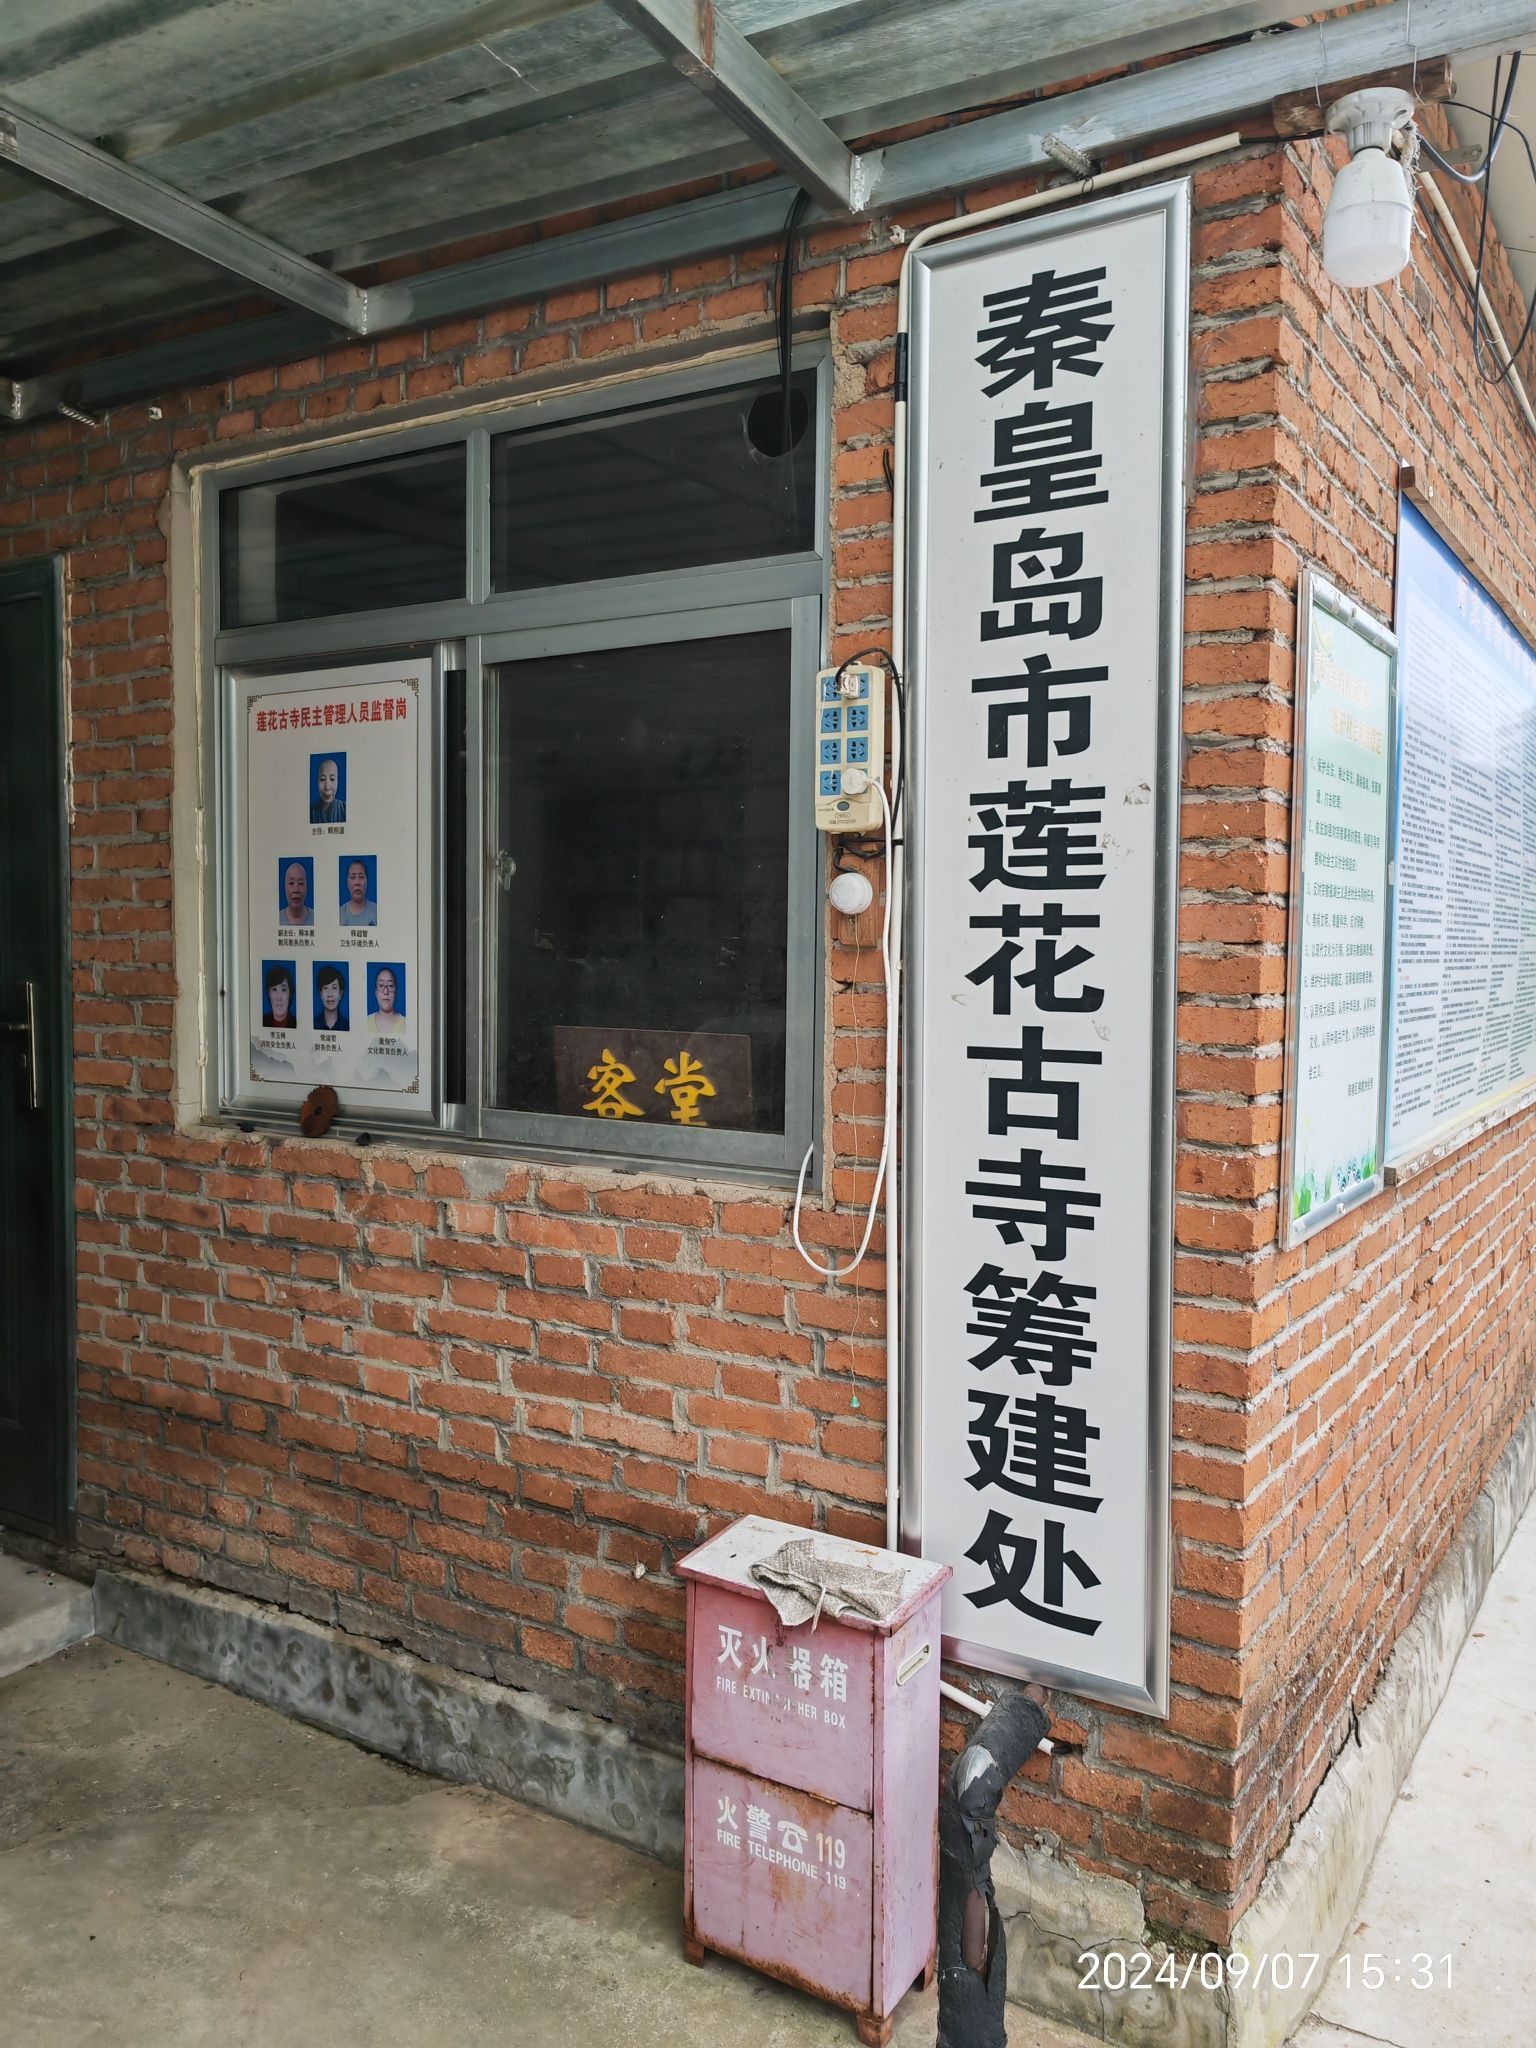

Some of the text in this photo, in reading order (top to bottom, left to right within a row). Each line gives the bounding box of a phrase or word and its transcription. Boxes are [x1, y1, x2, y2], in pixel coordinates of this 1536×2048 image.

[256, 697, 407, 732] 莲花古寺民主管理人员监督岗
[963, 267, 1114, 1637] 秦皇岛市莲花古寺筹建处
[582, 1048, 716, 1127] 客堂
[717, 1624, 848, 1703] 灭火器箱
[716, 1676, 737, 1694] FIRE
[824, 1710, 846, 1729] BOX
[716, 1795, 845, 1869] 火警 119
[717, 1829, 847, 1890] FIRE TELEPHONE 119
